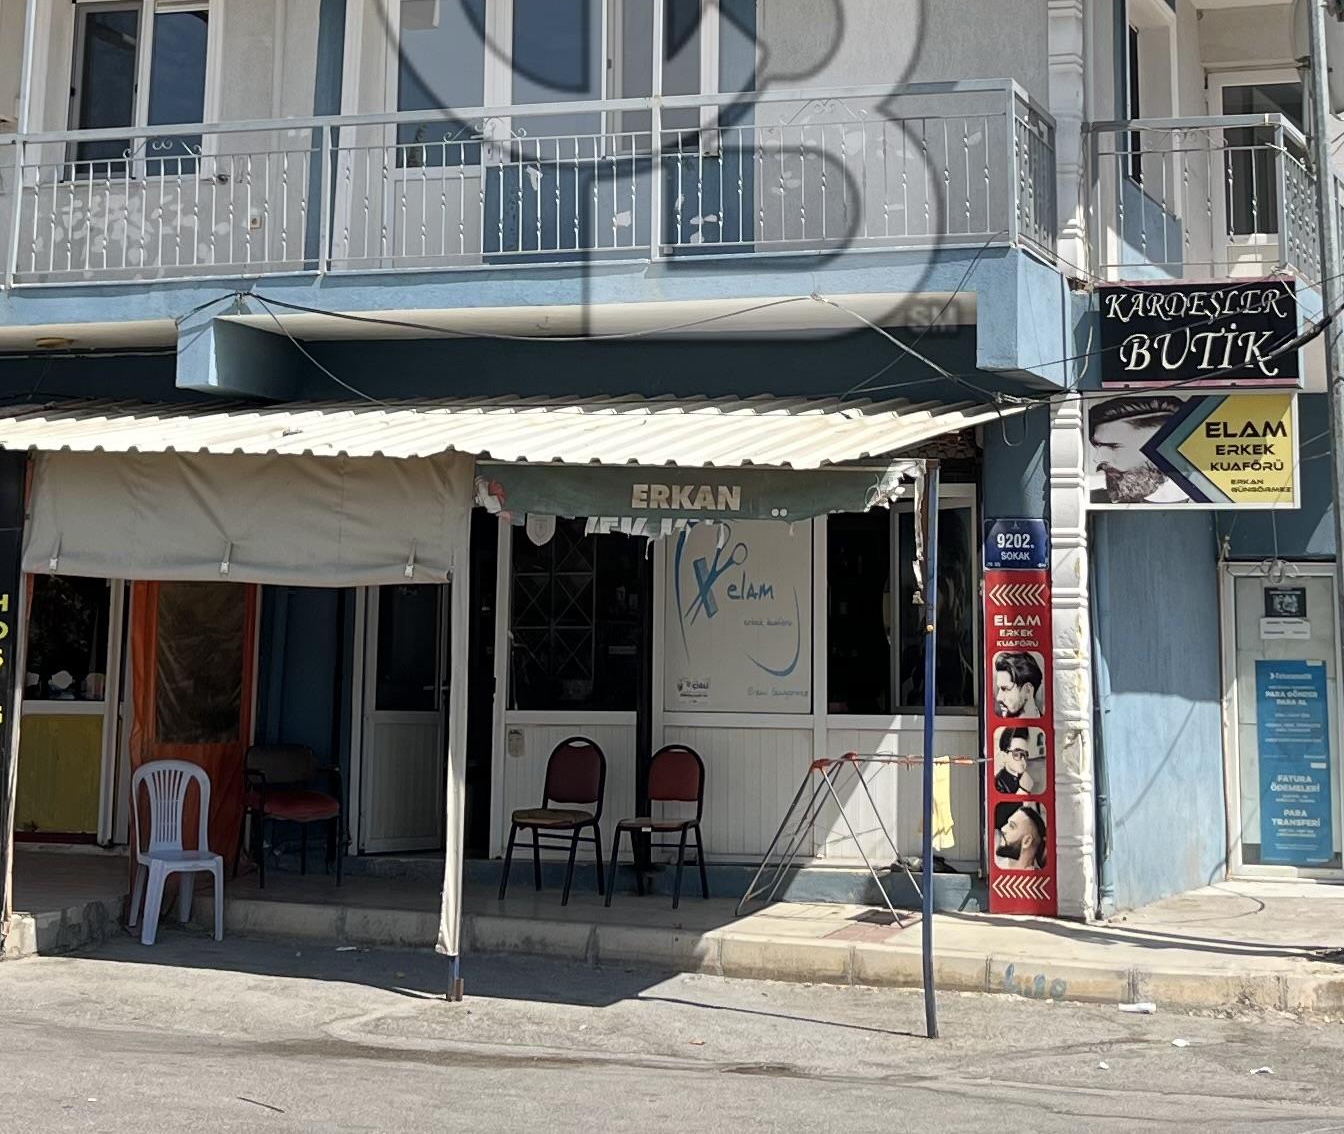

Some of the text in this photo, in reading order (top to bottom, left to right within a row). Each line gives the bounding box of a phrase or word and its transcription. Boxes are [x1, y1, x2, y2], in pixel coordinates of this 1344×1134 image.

[1105, 289, 1288, 325] KARDEŞLER
[1120, 322, 1279, 377] BUTİK
[1205, 420, 1287, 438] ELAM
[1216, 444, 1275, 456] ERKEK
[1210, 458, 1284, 472] KUAFÖRÜ
[631, 484, 742, 511] ERKAN
[1000, 551, 1031, 561] SOKAK
[994, 614, 1041, 627] ELAM
[999, 629, 1034, 637] ERKEK
[1277, 774, 1312, 783] FATURA
[1283, 809, 1307, 817] PARA
